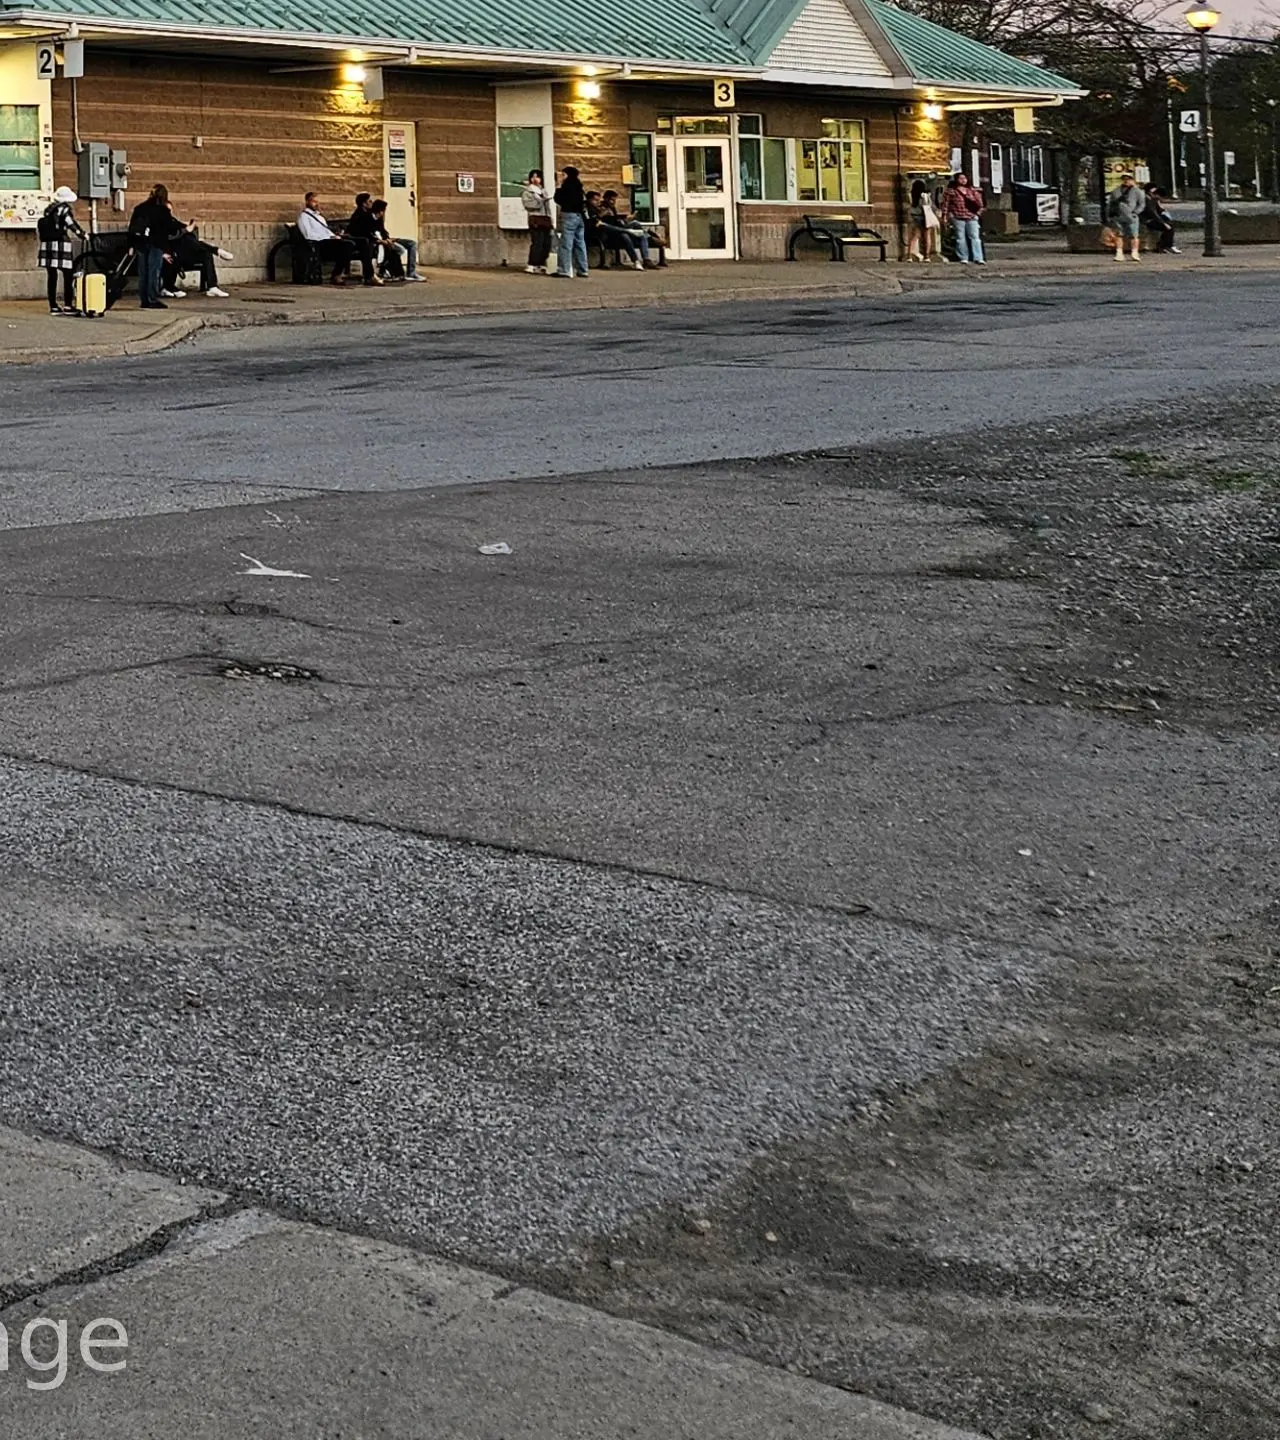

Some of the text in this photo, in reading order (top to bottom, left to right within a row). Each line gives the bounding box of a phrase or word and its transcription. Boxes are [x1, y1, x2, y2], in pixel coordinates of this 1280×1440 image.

[40, 49, 52, 73] 2
[717, 84, 731, 101] 3
[1184, 113, 1196, 128] 4
